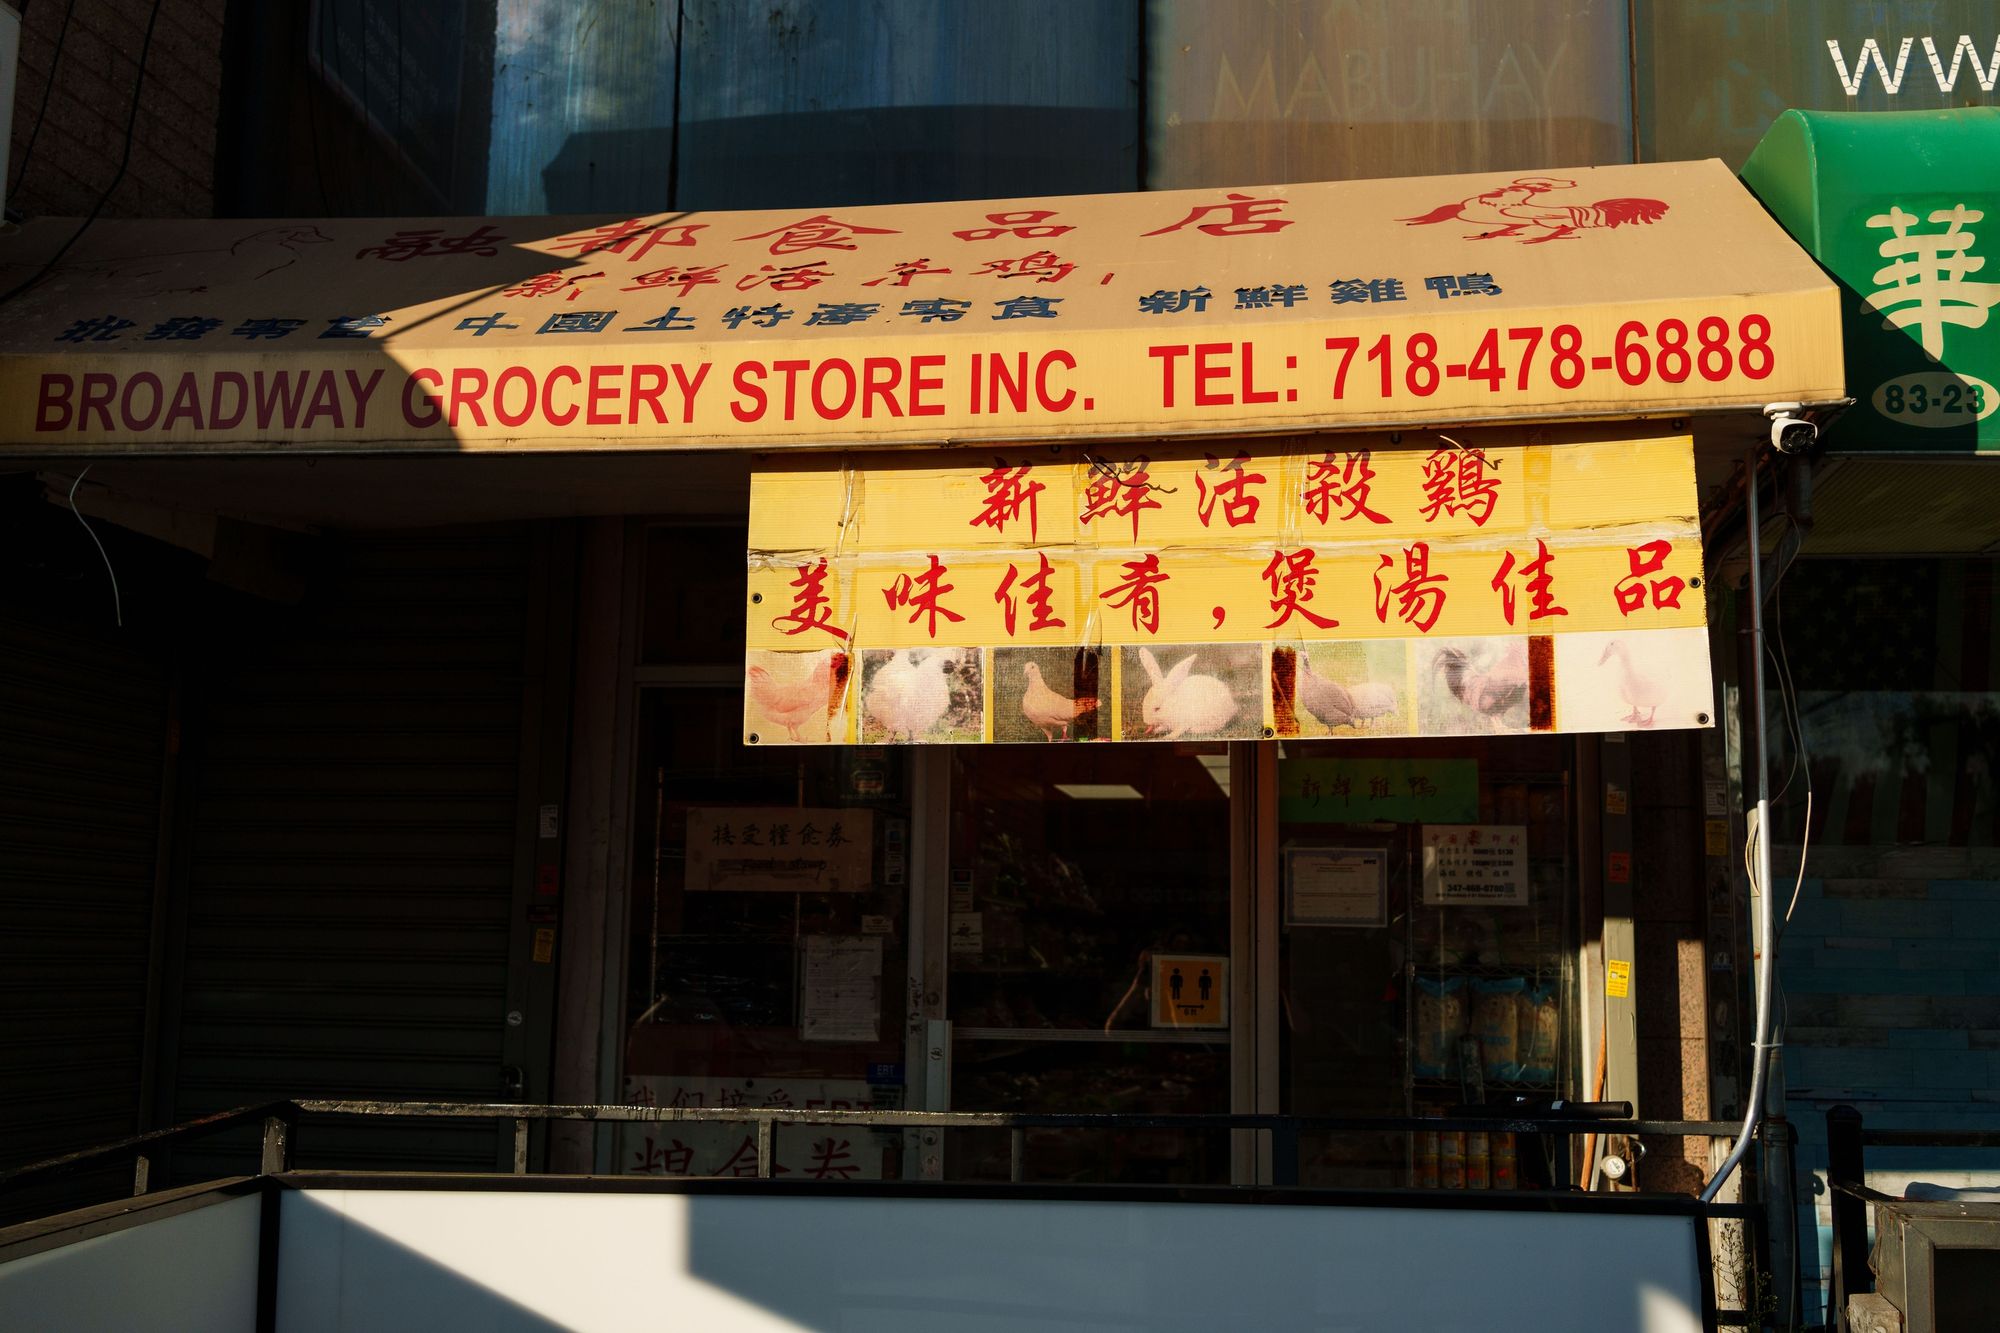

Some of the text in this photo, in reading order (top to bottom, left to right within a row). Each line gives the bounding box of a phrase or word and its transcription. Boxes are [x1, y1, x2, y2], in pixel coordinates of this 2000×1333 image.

[1212, 41, 1568, 119] MABUHAY
[1860, 203, 2000, 363] 華
[35, 313, 1775, 432] BROADWAY GROCERY STORE INC. TEL: 718-478-6888
[1885, 384, 1986, 414] 83-23
